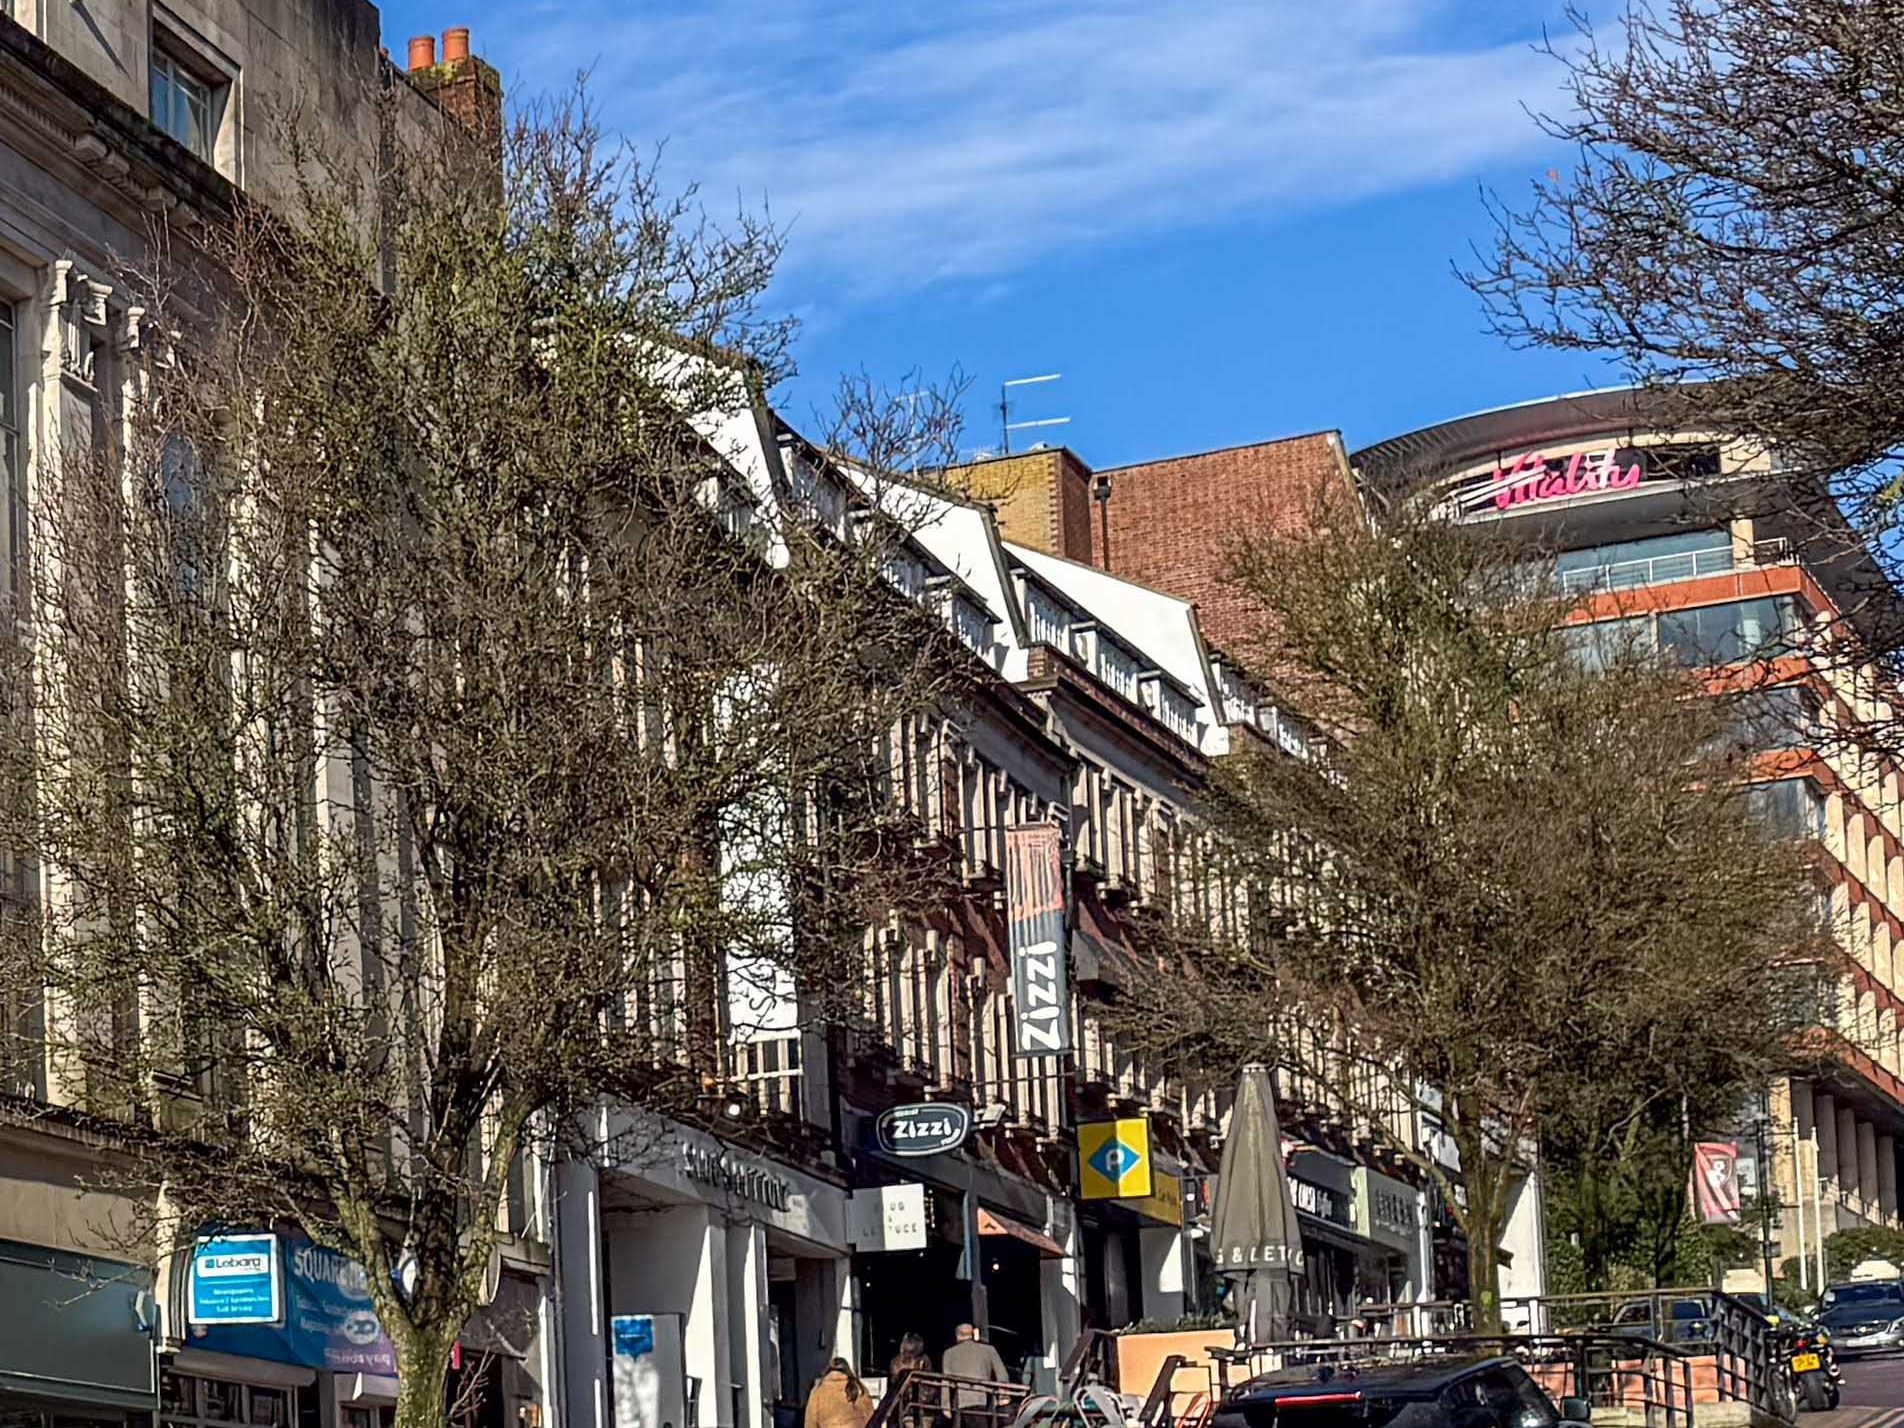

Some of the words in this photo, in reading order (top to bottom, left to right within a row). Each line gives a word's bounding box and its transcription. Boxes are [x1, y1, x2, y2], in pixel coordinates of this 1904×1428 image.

[1018, 940, 1062, 1051] Zizzi
[893, 1117, 952, 1139] Zizzi
[215, 1257, 261, 1269] Lebara
